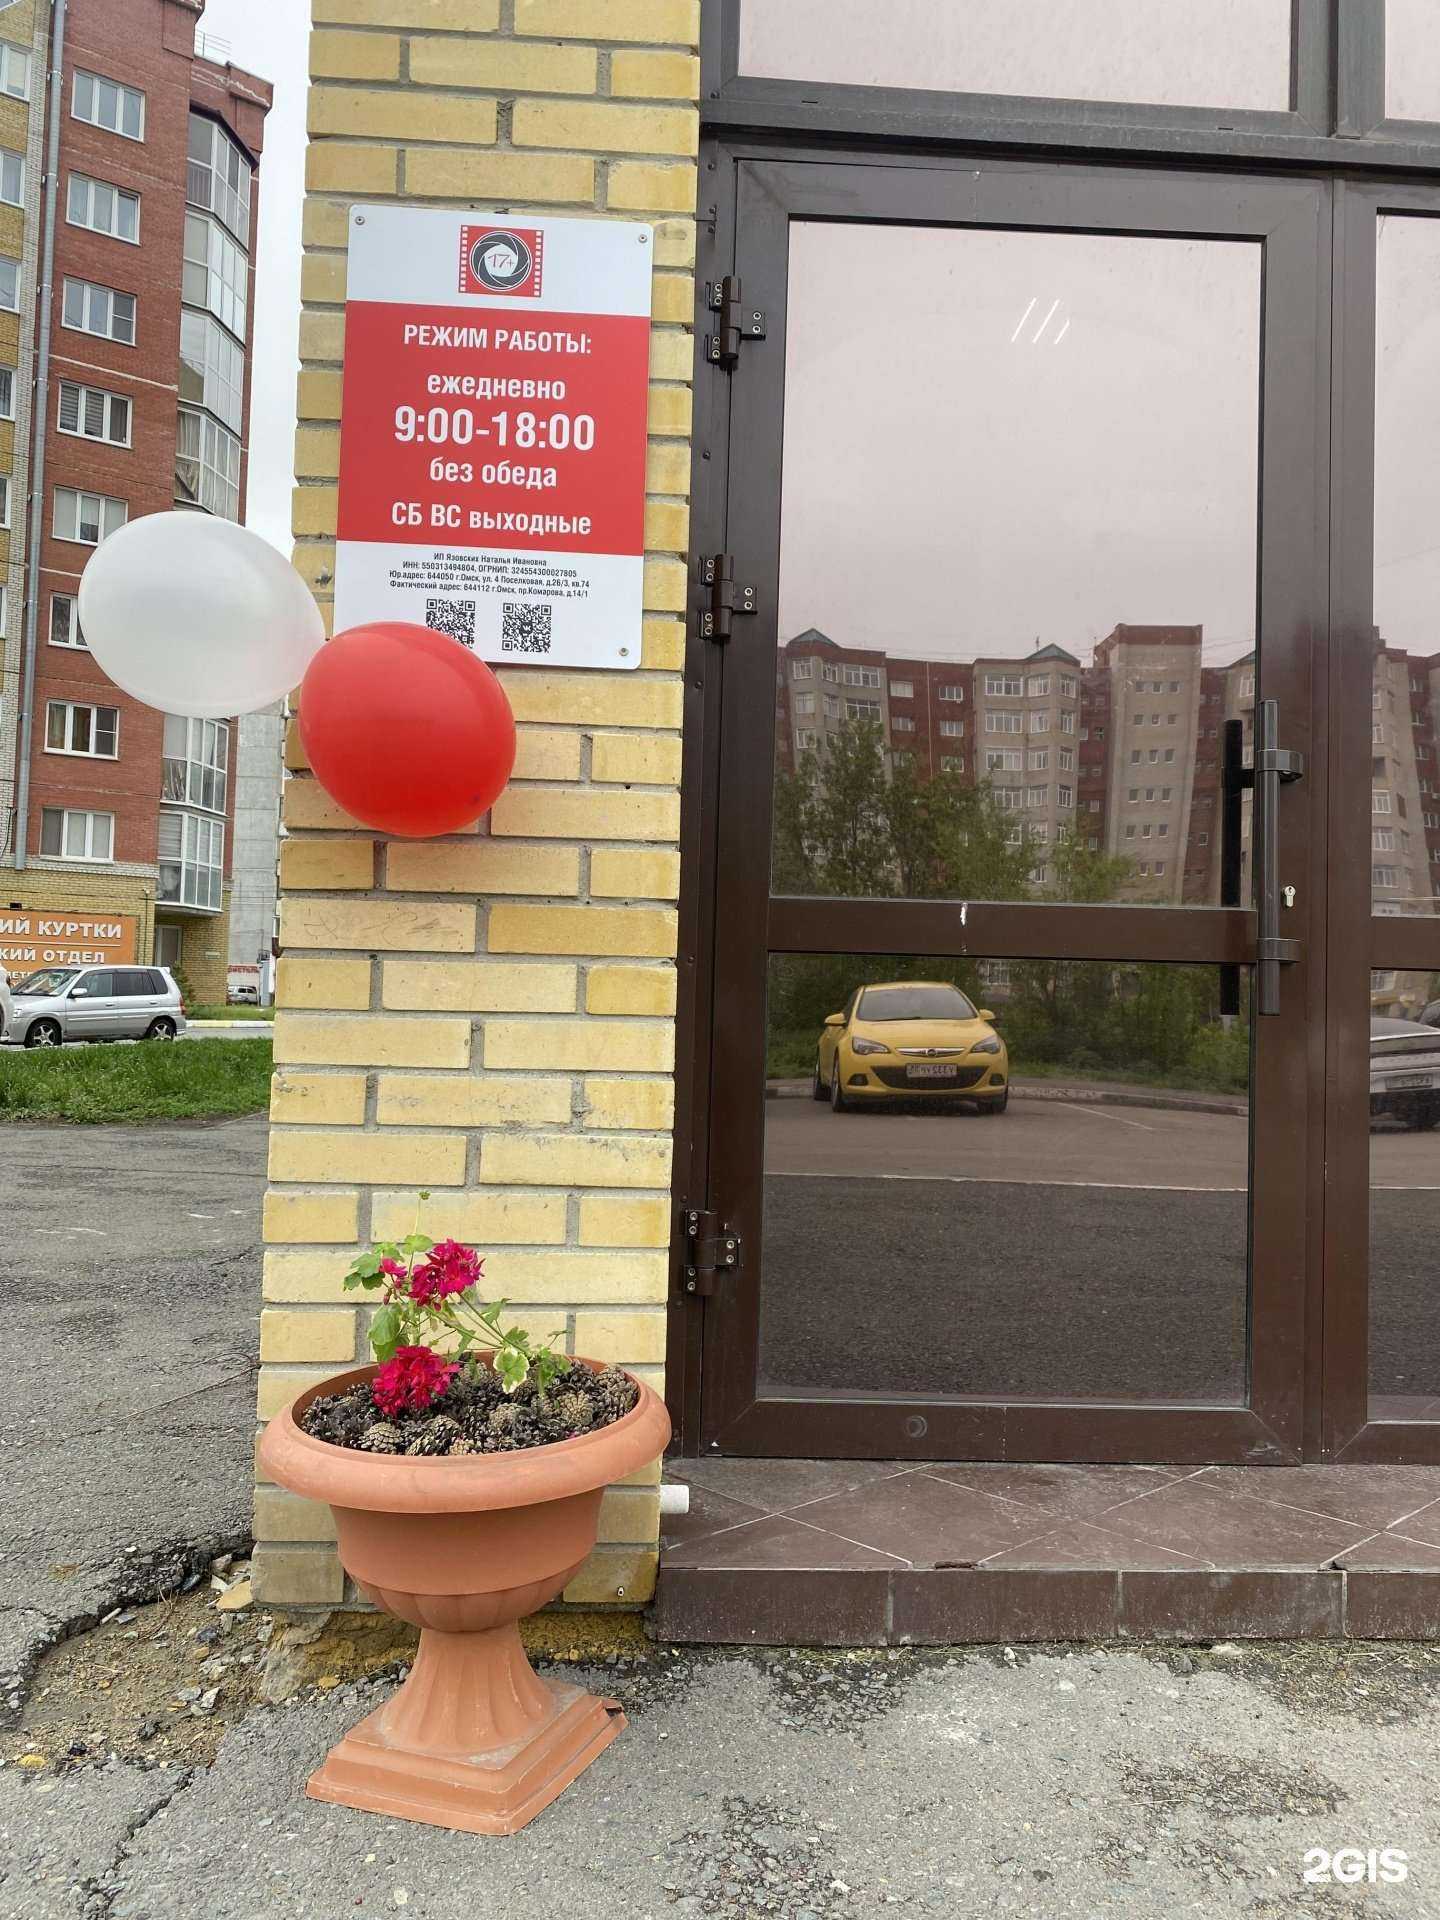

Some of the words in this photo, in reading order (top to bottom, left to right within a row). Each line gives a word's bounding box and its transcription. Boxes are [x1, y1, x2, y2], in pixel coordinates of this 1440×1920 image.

[404, 324, 488, 348] РЕЖИМ
[494, 329, 592, 354] РАБОТЫ:
[427, 374, 566, 400] ежедневно
[394, 405, 595, 450] 9:00-18:00
[430, 457, 473, 482] без
[482, 460, 557, 489] обеда
[391, 502, 422, 525] СБ
[431, 504, 461, 528] ВС
[469, 511, 591, 535] выходные
[402, 561, 420, 569] ИНН:
[478, 564, 510, 574] ОГРНИП:
[434, 552, 444, 560] ИП
[446, 553, 479, 562] Язовских
[481, 555, 511, 564] Наталья
[513, 557, 547, 566] Ивановна
[389, 580, 437, 590] Фактический
[463, 583, 490, 592] 644112
[427, 572, 454, 581] 644050
[482, 576, 492, 584] ул.
[501, 576, 545, 586] Поселковая,
[571, 580, 590, 588] кв.74
[38, 920, 122, 939] КУРТКИ
[42, 949, 105, 965] ОТДЕЛ
